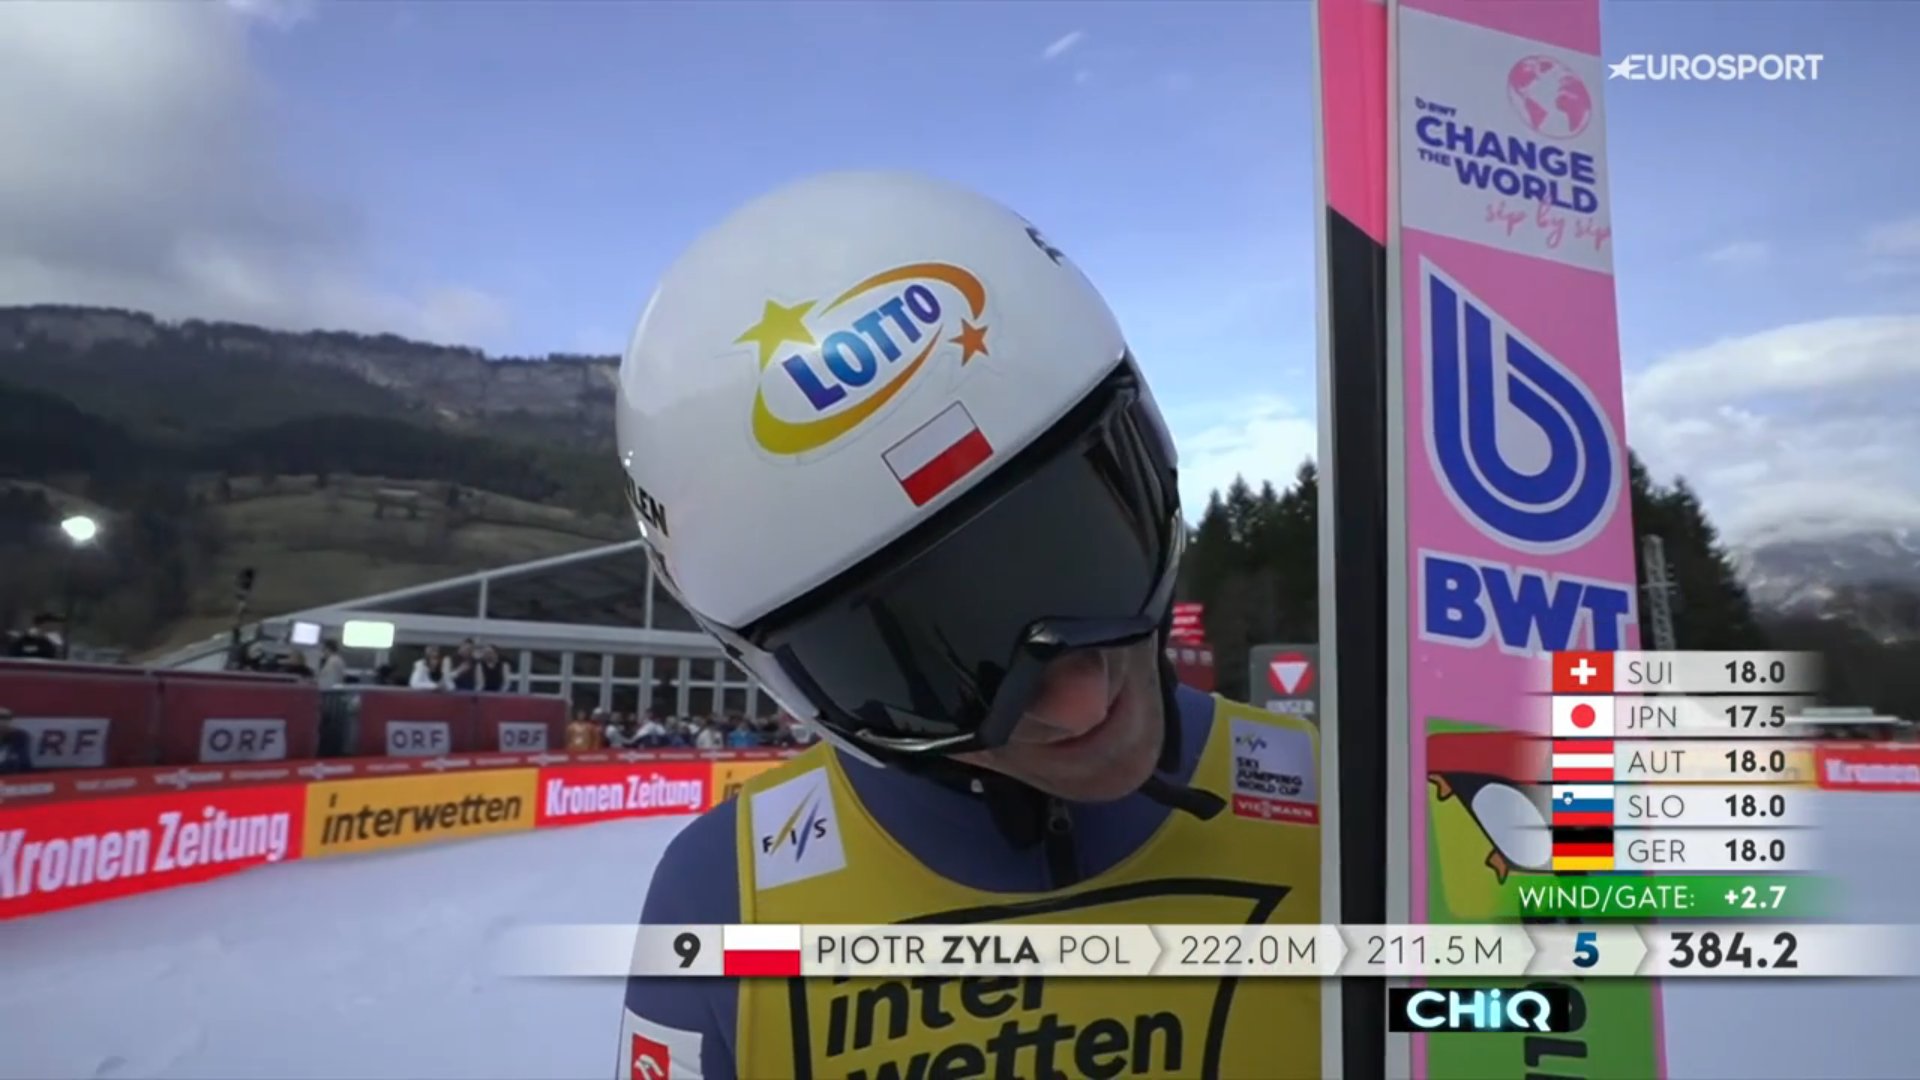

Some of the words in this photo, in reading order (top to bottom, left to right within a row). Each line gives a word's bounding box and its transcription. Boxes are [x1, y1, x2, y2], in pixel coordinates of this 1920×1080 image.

[1416, 115, 1596, 185] CHANGE
[1417, 147, 1451, 167] THE
[1454, 157, 1598, 214] WORLD
[782, 284, 941, 411] LOTTO
[1425, 556, 1629, 652] BWT
[38, 729, 98, 757] RF
[208, 728, 279, 752] ORF
[391, 729, 443, 749] ORF
[503, 729, 547, 747] ORF
[321, 793, 523, 845] interwetten
[546, 777, 625, 817] Kronen
[625, 772, 704, 810] Zeitung
[0, 828, 151, 898] Kronen
[152, 805, 291, 872] Zeitung
